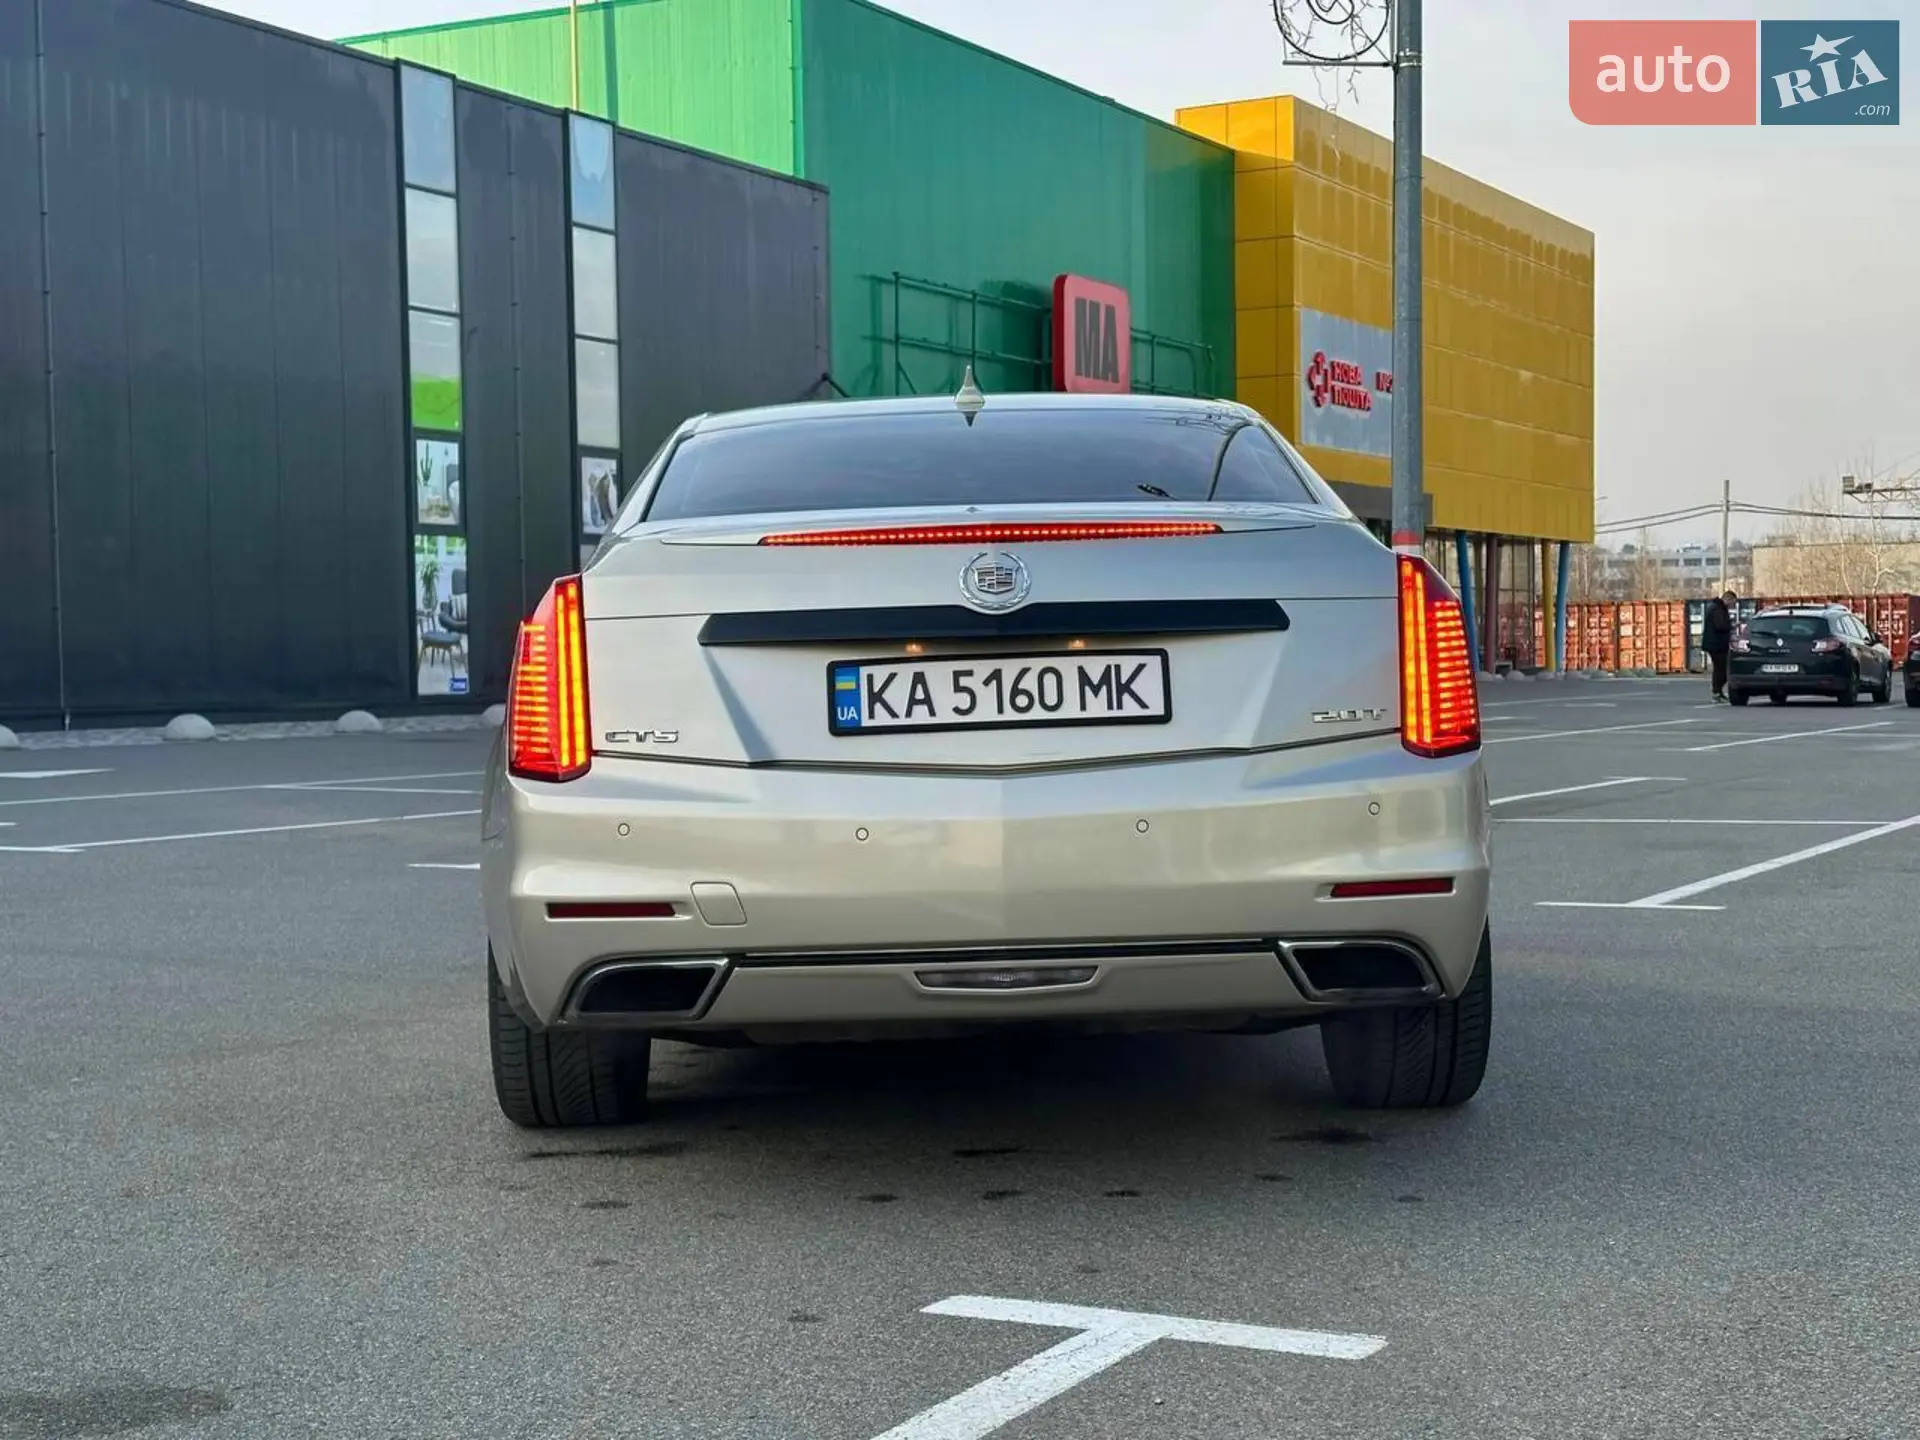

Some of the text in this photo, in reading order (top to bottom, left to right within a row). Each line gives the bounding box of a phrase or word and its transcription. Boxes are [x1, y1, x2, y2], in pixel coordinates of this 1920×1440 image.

[1330, 360, 1362, 386] НОВА
[1330, 385, 1372, 412] ПОШТА
[866, 663, 1150, 720] KA 5160 MK
[836, 706, 859, 721] UA
[605, 729, 679, 744] CTS
